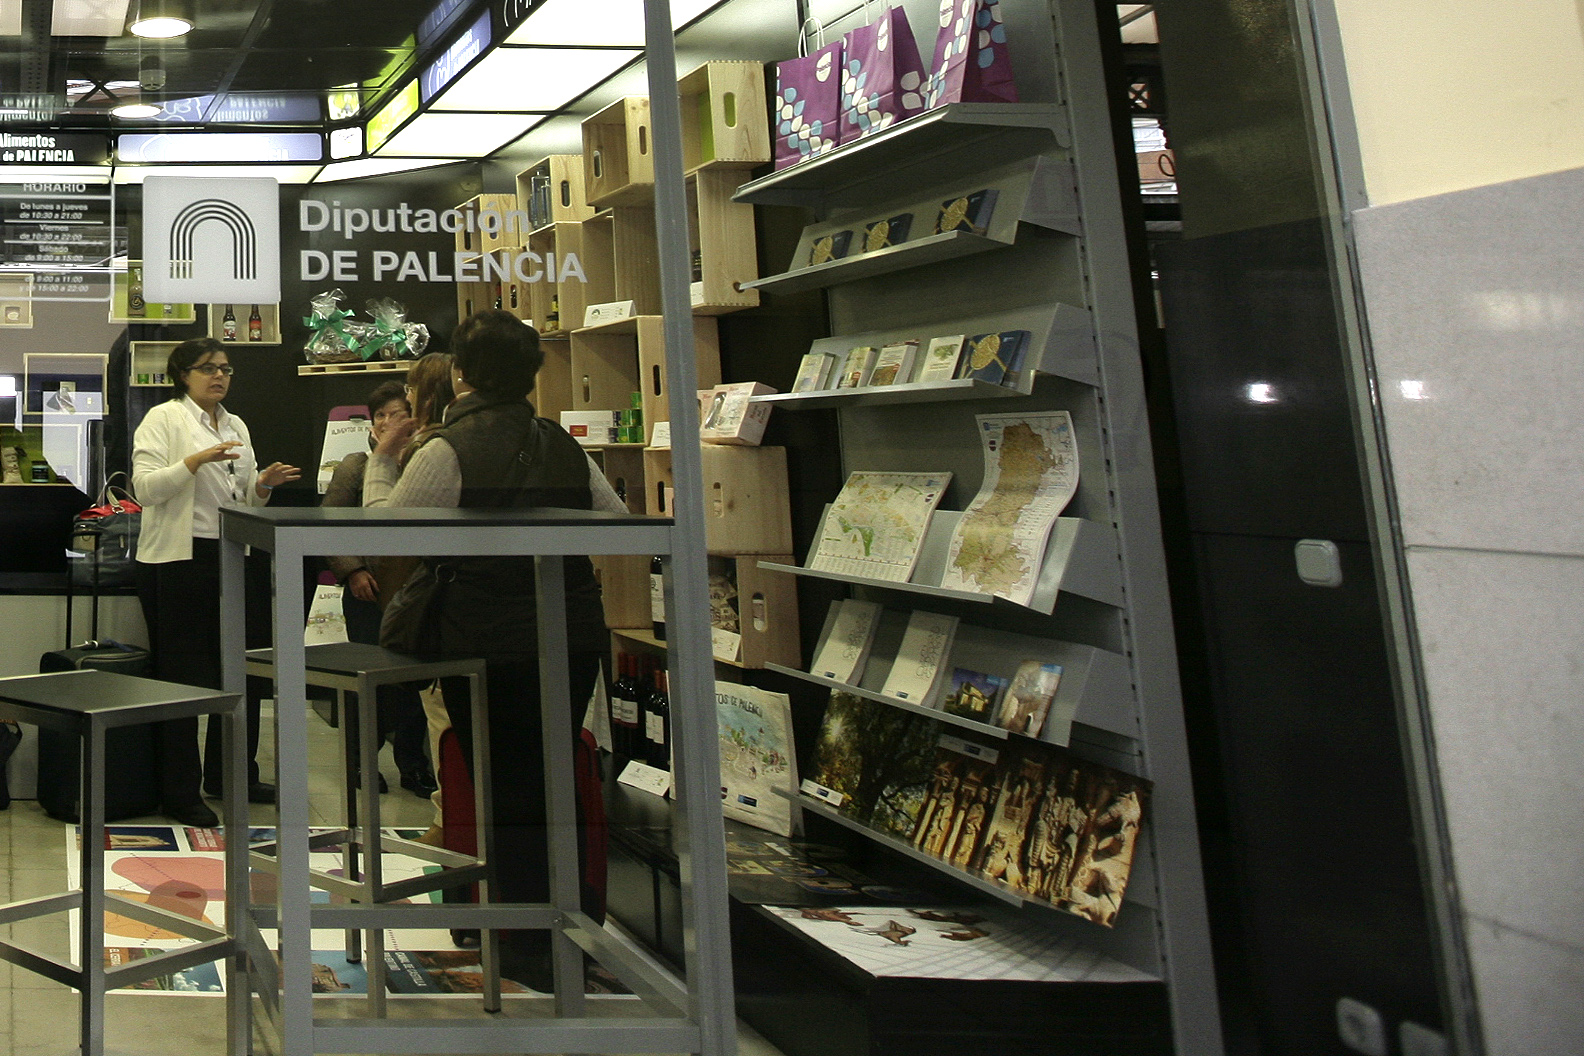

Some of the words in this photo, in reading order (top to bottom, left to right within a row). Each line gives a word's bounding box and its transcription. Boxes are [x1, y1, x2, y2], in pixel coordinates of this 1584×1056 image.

[2, 150, 14, 162] de
[17, 150, 75, 162] PALENCIA
[23, 181, 86, 193] HORARIO
[32, 203, 54, 211] lunes
[62, 203, 88, 212] jueves
[61, 212, 83, 220] 21:00
[299, 199, 529, 240] Diputación
[300, 249, 359, 282] DE
[372, 250, 588, 283] PALENCIA
